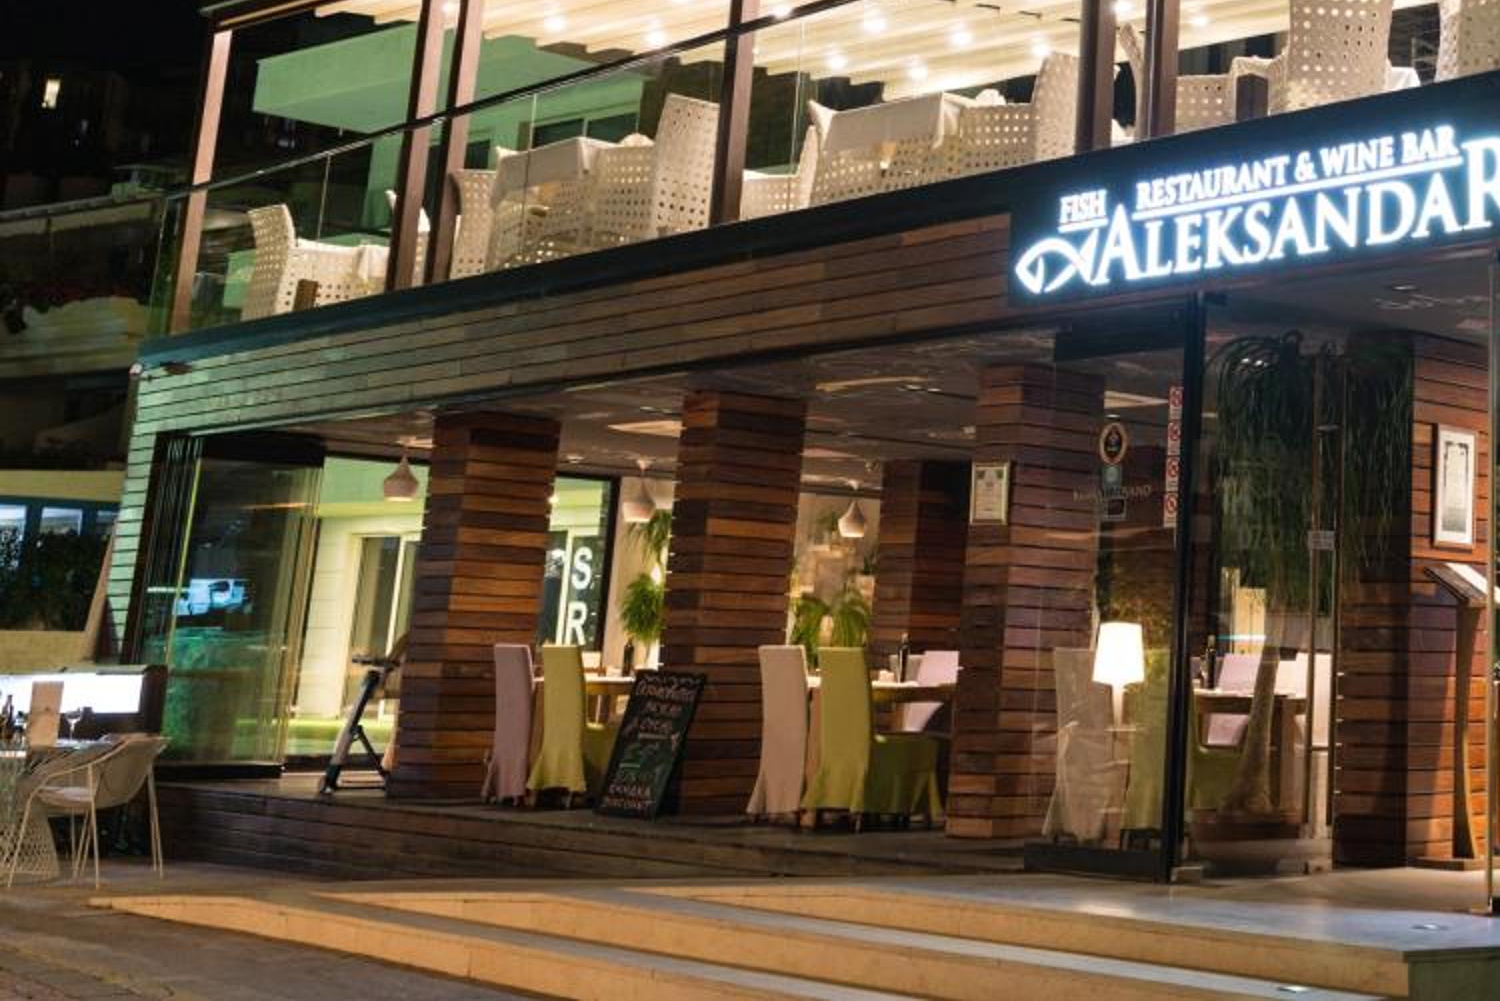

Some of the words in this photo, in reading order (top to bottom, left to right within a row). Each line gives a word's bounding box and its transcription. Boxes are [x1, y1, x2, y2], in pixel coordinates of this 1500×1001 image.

[1059, 188, 1108, 224] FISH
[1135, 154, 1290, 211] RESTAURANT
[1294, 150, 1318, 183] &
[1319, 135, 1396, 178] WINE
[1401, 124, 1460, 164] BAR
